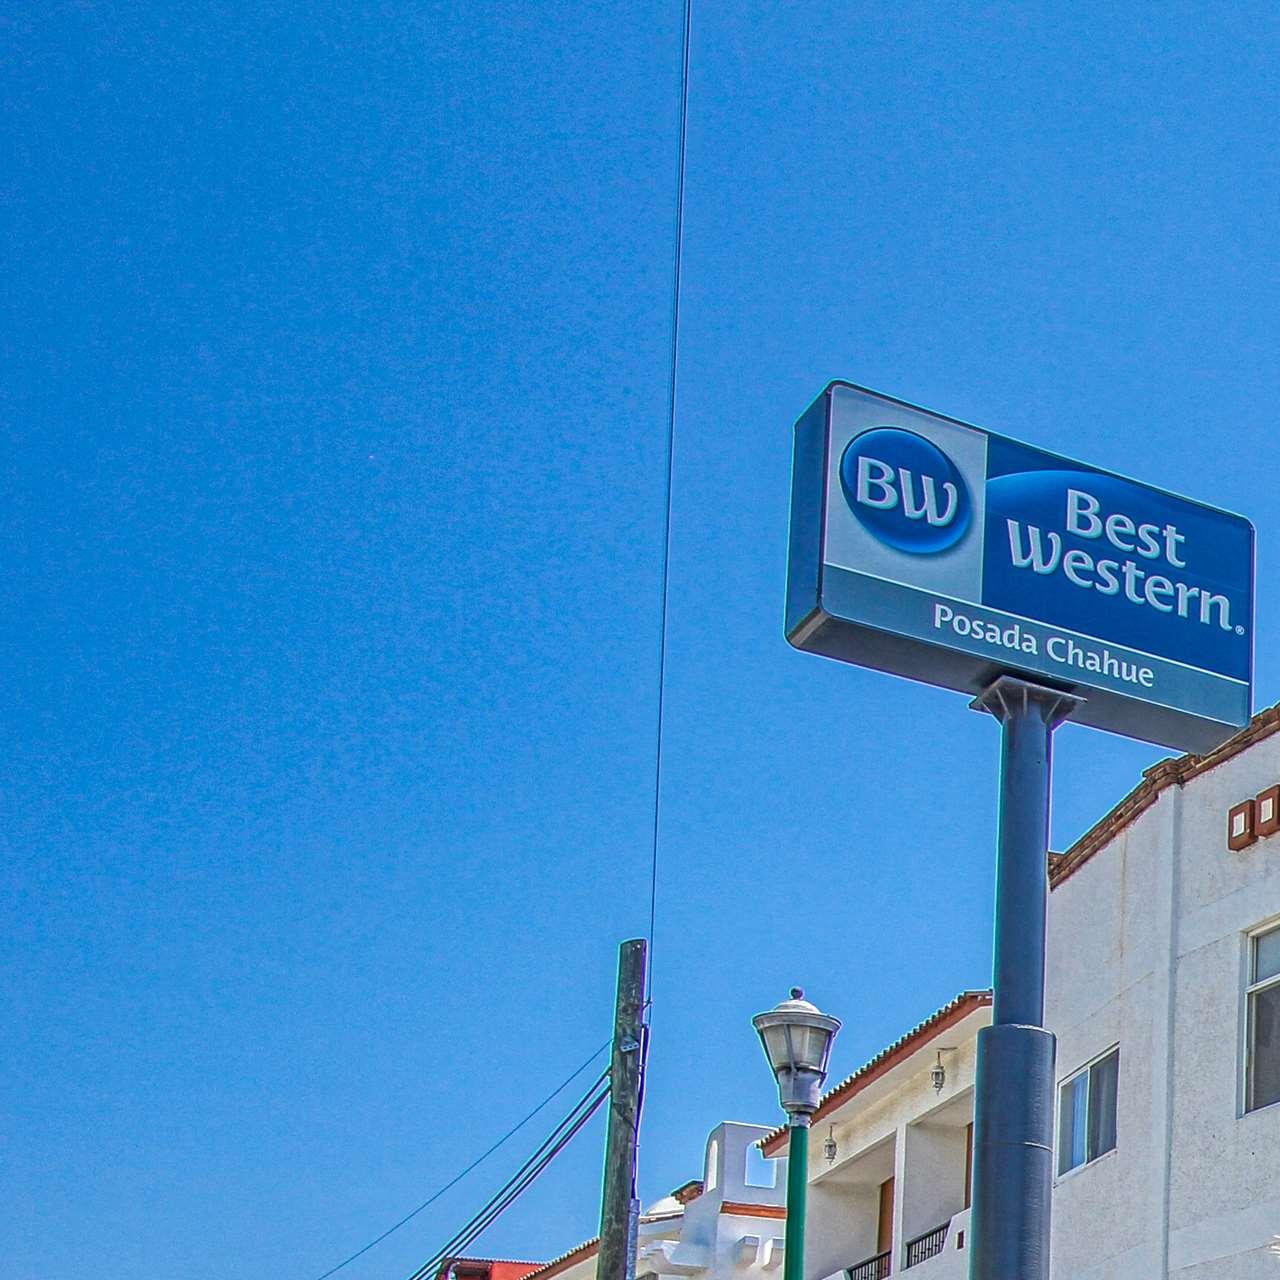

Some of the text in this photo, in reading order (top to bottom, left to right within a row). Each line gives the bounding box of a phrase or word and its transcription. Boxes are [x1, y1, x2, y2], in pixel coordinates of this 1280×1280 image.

[857, 455, 958, 527] BW
[1066, 488, 1187, 569] Best
[933, 603, 1154, 688] Posada Chahue
